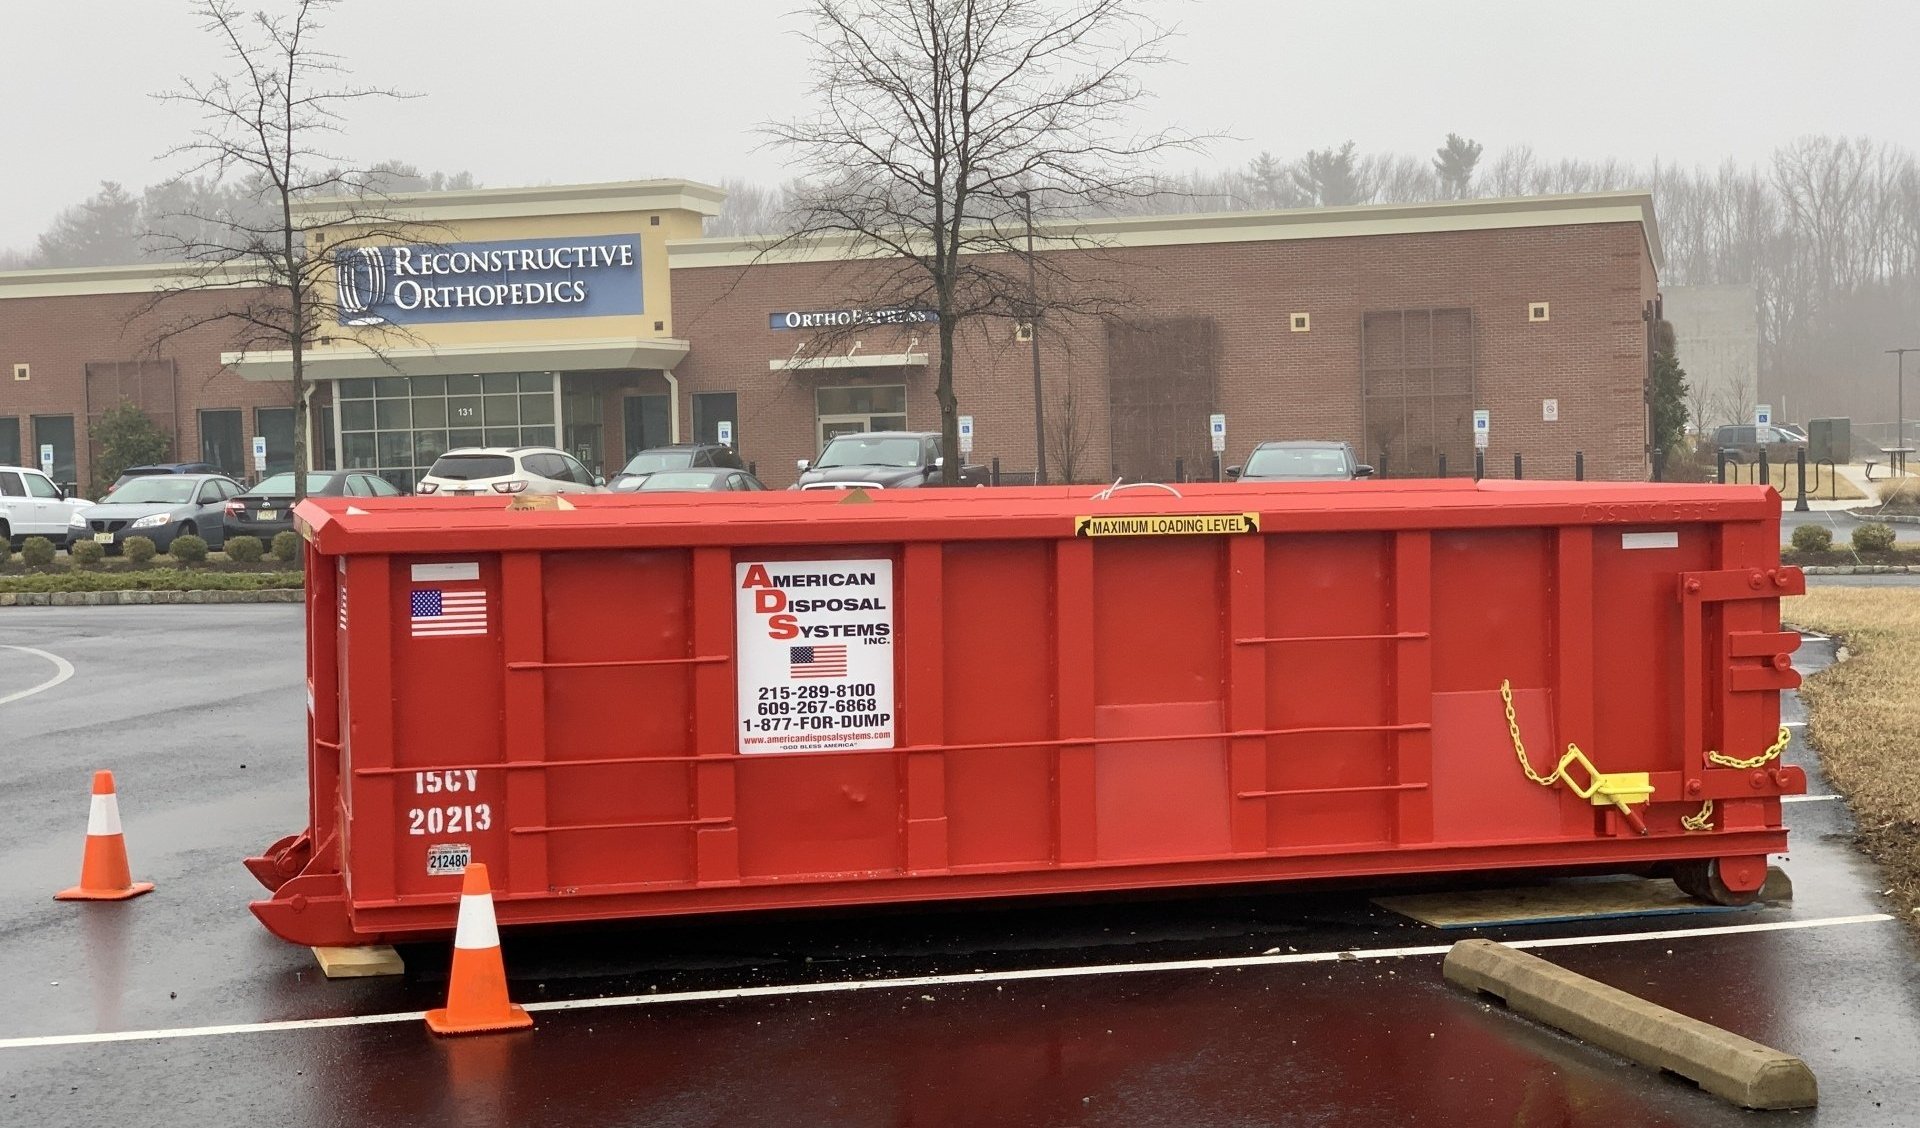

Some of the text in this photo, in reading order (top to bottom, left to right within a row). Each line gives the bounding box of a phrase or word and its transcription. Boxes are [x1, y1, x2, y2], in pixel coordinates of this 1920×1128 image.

[393, 244, 634, 277] RECONSTRUCTIVE
[393, 280, 586, 310] ORTHOPEDICS
[457, 407, 473, 416] 131
[1092, 518, 1243, 535] MAXIMUM LOADING LEVEL
[741, 564, 876, 589] AMERICAN
[755, 589, 886, 614] DISPOSAL
[768, 614, 891, 639] SYSTEMS
[863, 637, 891, 645] INC.
[758, 683, 876, 700] 215-289-8100
[757, 699, 877, 715] 609-267-6868
[742, 713, 891, 732] 1-877-FOR-DUMP
[743, 731, 891, 745] www.americandisposalsystems.com
[416, 769, 478, 794] 15CY
[409, 803, 491, 835] 20213
[430, 854, 468, 868] 212480
